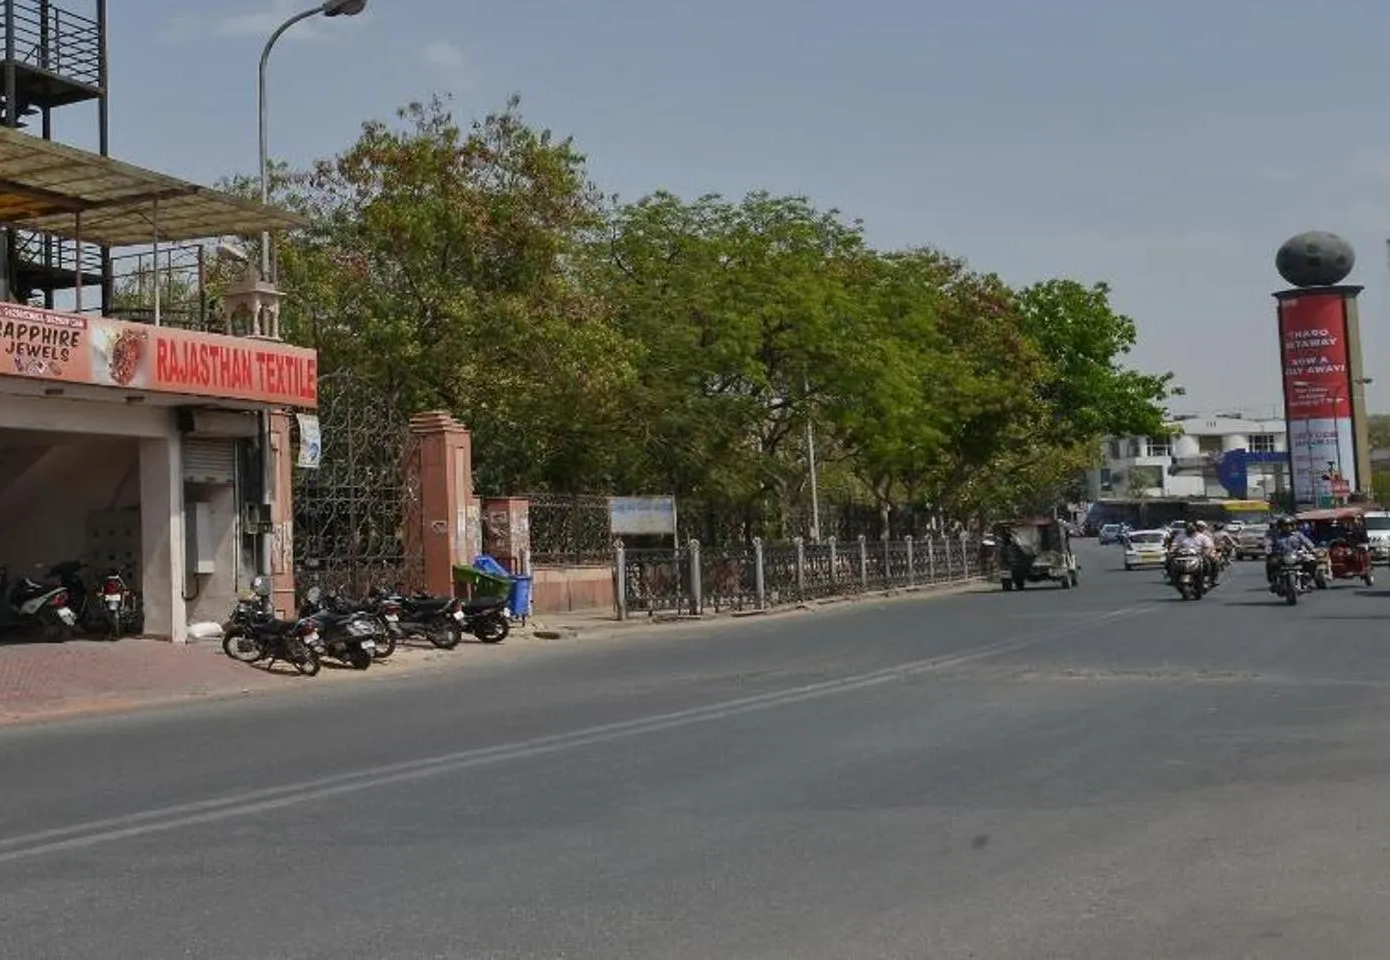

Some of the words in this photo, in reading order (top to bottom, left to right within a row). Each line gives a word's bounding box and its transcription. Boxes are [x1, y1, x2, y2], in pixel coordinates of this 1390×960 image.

[5, 341, 70, 362] JEWELS
[156, 338, 253, 391] RAJASTHAN
[256, 351, 316, 399] TEXTILE
